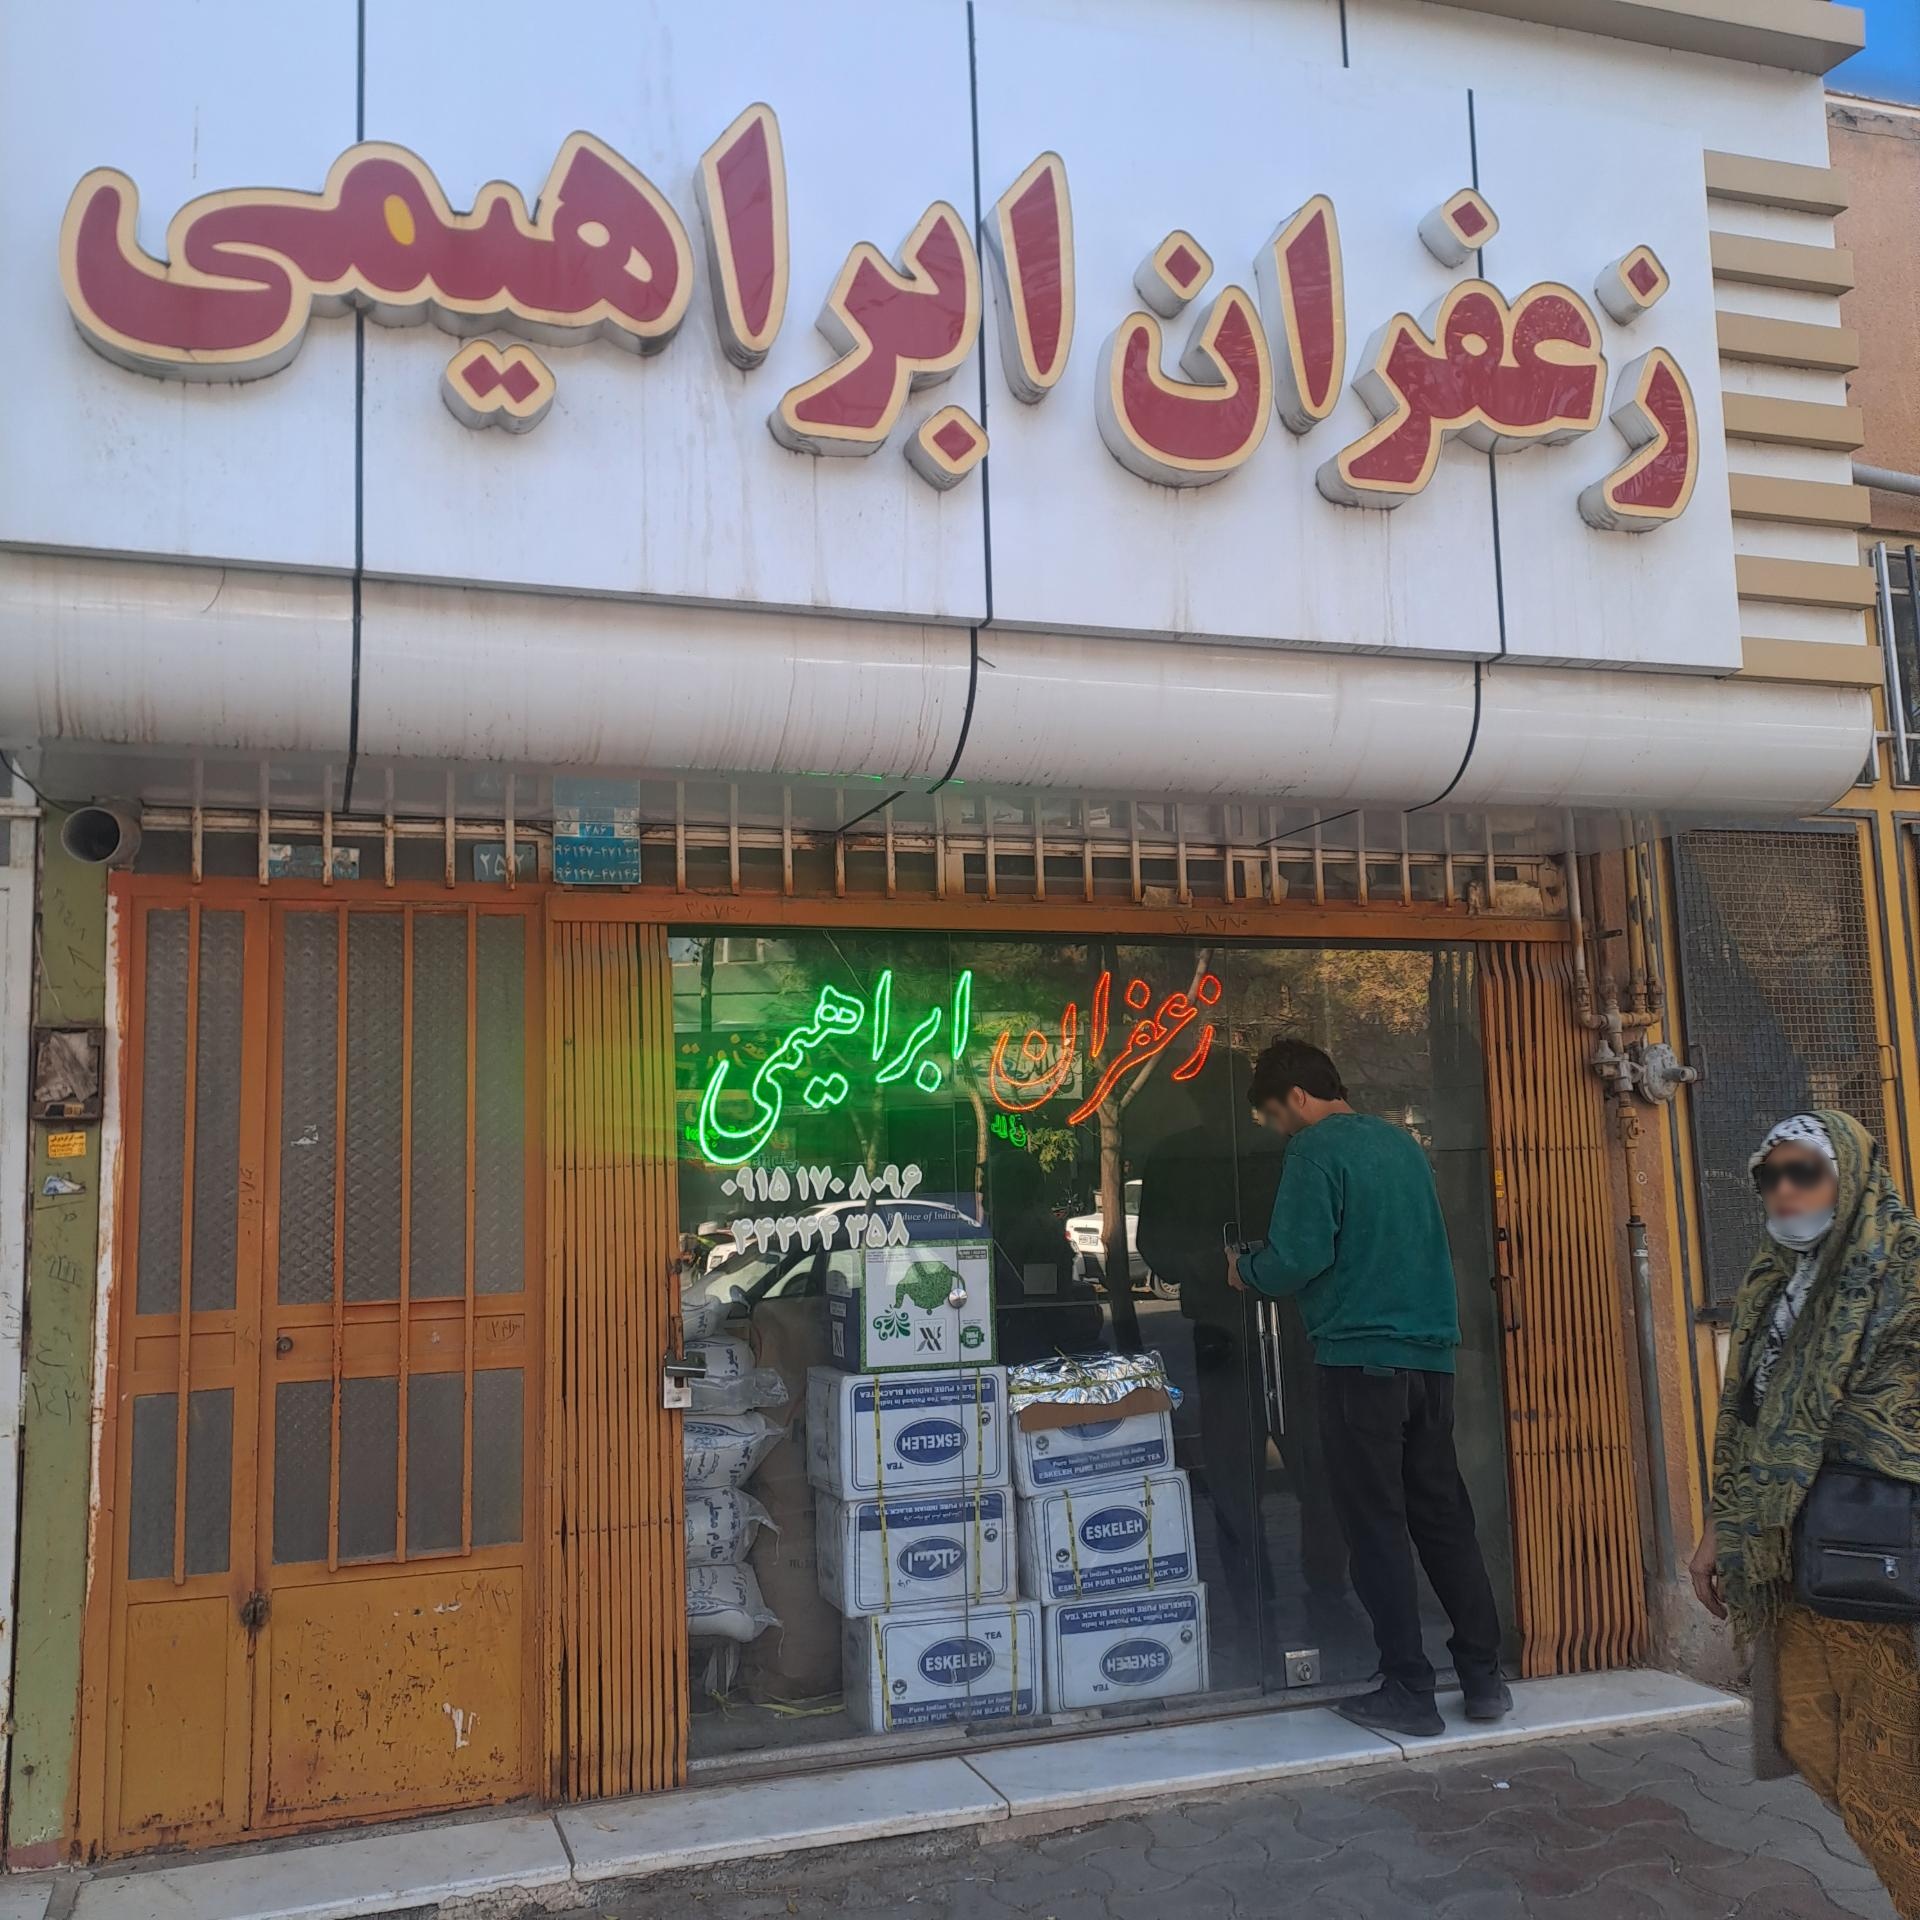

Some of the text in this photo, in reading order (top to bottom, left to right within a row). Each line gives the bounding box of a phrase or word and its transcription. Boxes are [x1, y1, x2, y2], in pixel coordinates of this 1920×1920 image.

[60, 102, 1698, 532] زعفران ابراهیمی
[699, 969, 1222, 1165] زعفران ابراهیمی
[887, 1213, 921, 1221] Pduce
[923, 1211, 932, 1223] of
[957, 1382, 991, 1393] ESELEH
[901, 1432, 961, 1451] ESKELEH
[886, 1462, 904, 1470] TEA
[1085, 1518, 1144, 1541] ESKELEH
[907, 1548, 961, 1573] اسکله
[1058, 1582, 1094, 1592] ESKEH
[1095, 1577, 1117, 1587] PURE
[1118, 1573, 1143, 1583] INDIAN
[1143, 1569, 1168, 1580] BACK
[984, 1631, 1002, 1640] TEA
[925, 1651, 988, 1672] ESKELEH
[1092, 1683, 1109, 1692] TEA
